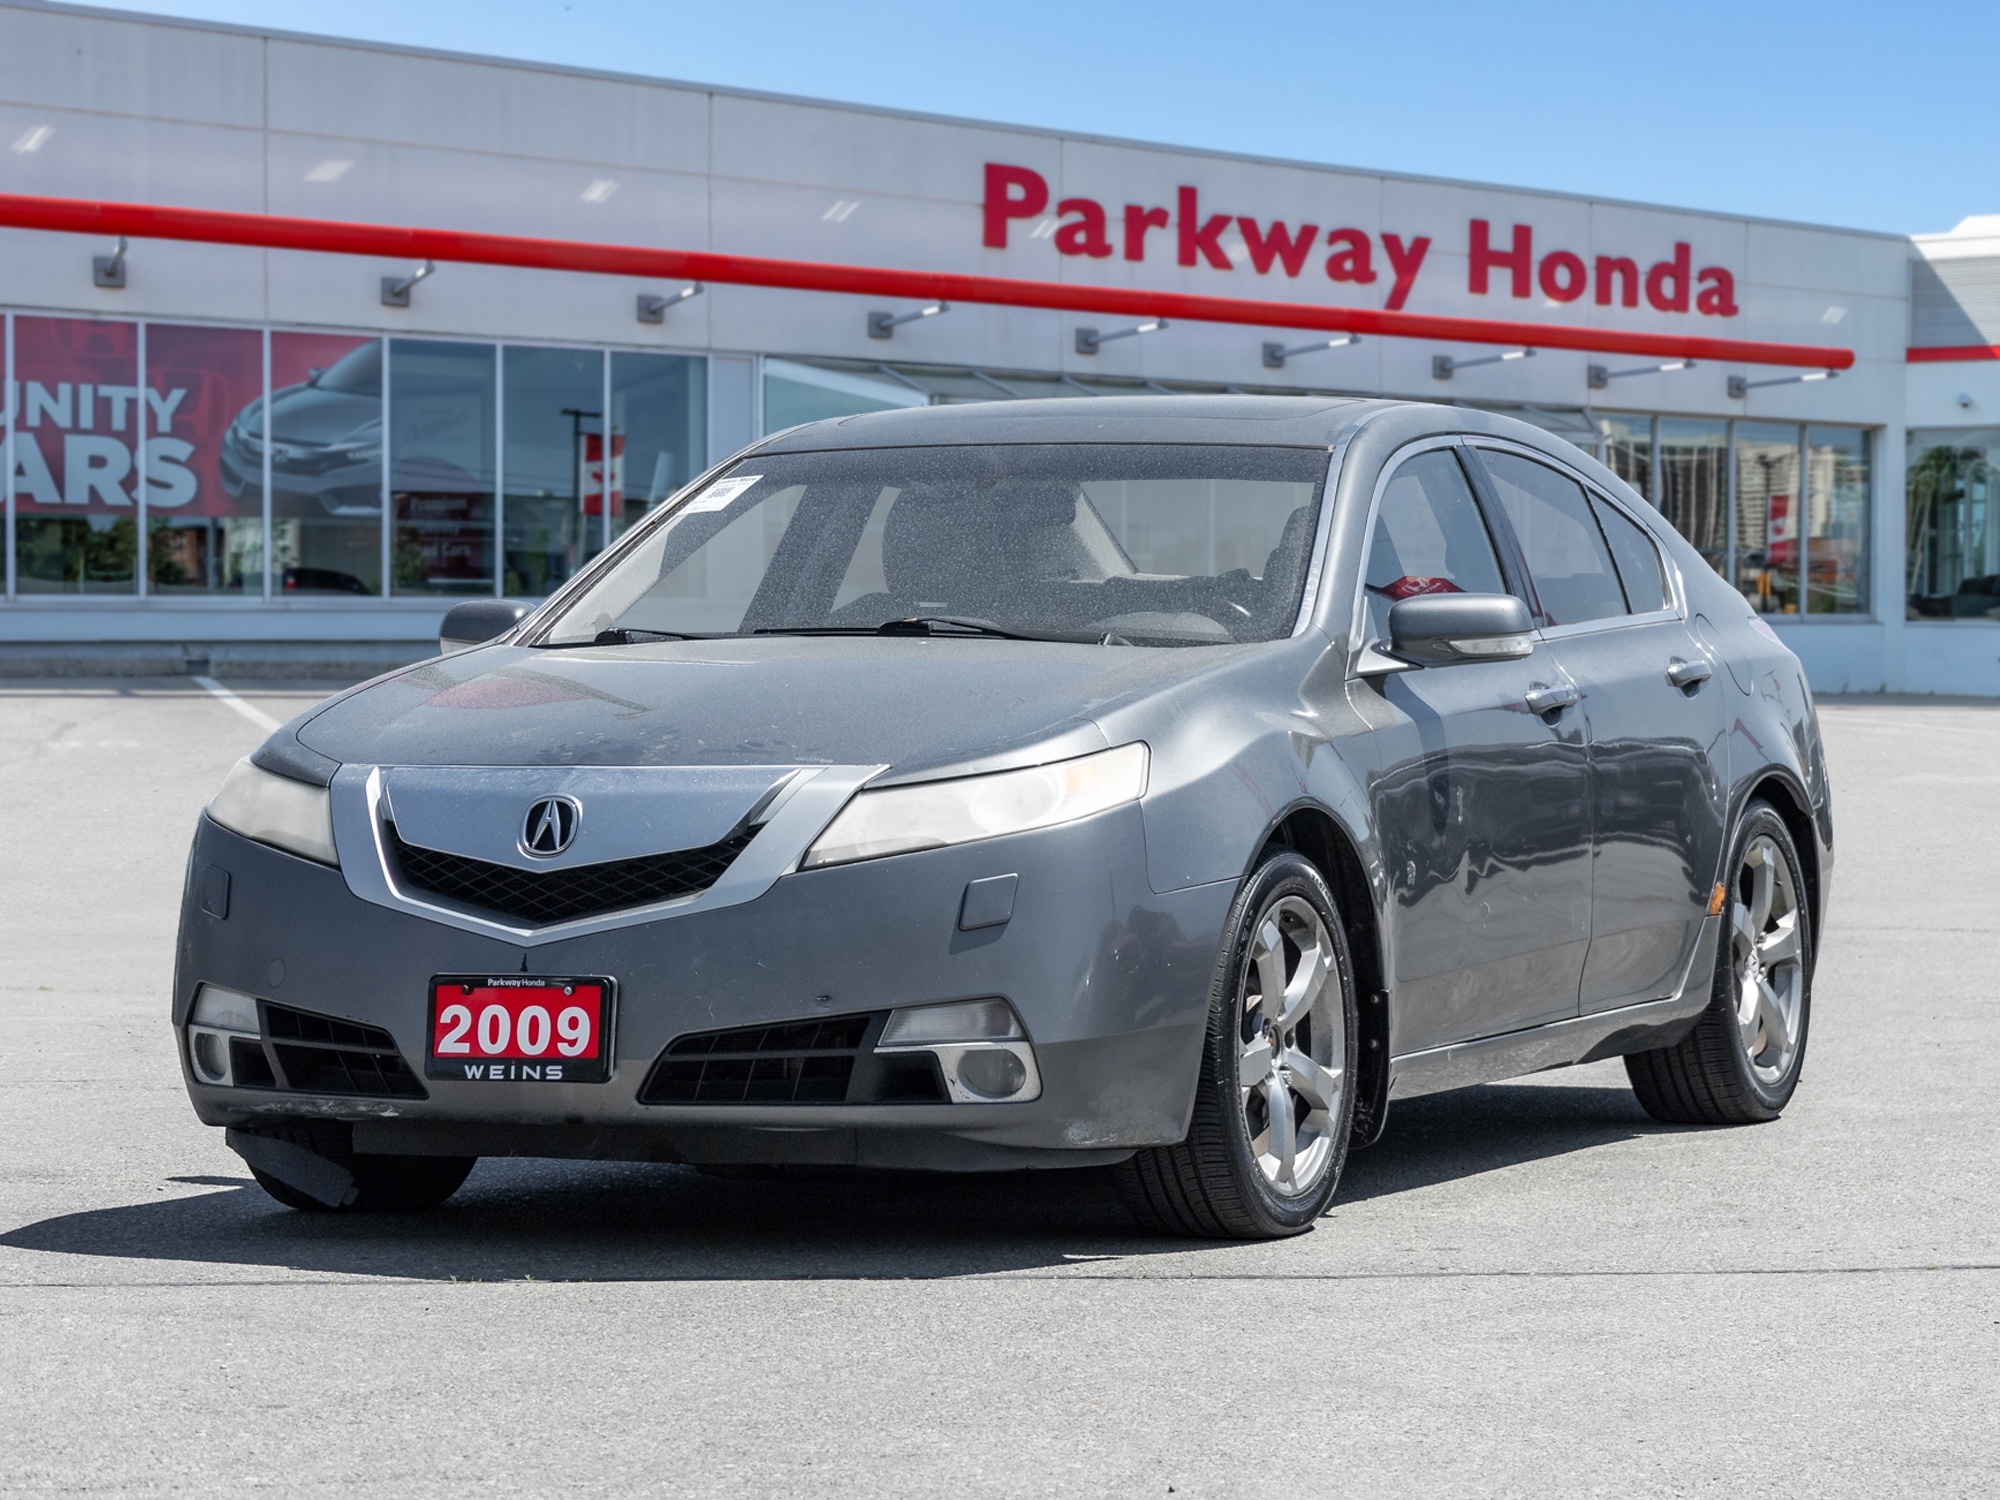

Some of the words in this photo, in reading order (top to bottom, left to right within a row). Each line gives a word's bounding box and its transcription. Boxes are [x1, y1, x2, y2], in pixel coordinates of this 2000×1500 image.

[983, 163, 1432, 311] Parkway
[1467, 218, 1739, 317] Honda
[437, 1004, 591, 1057] 2009
